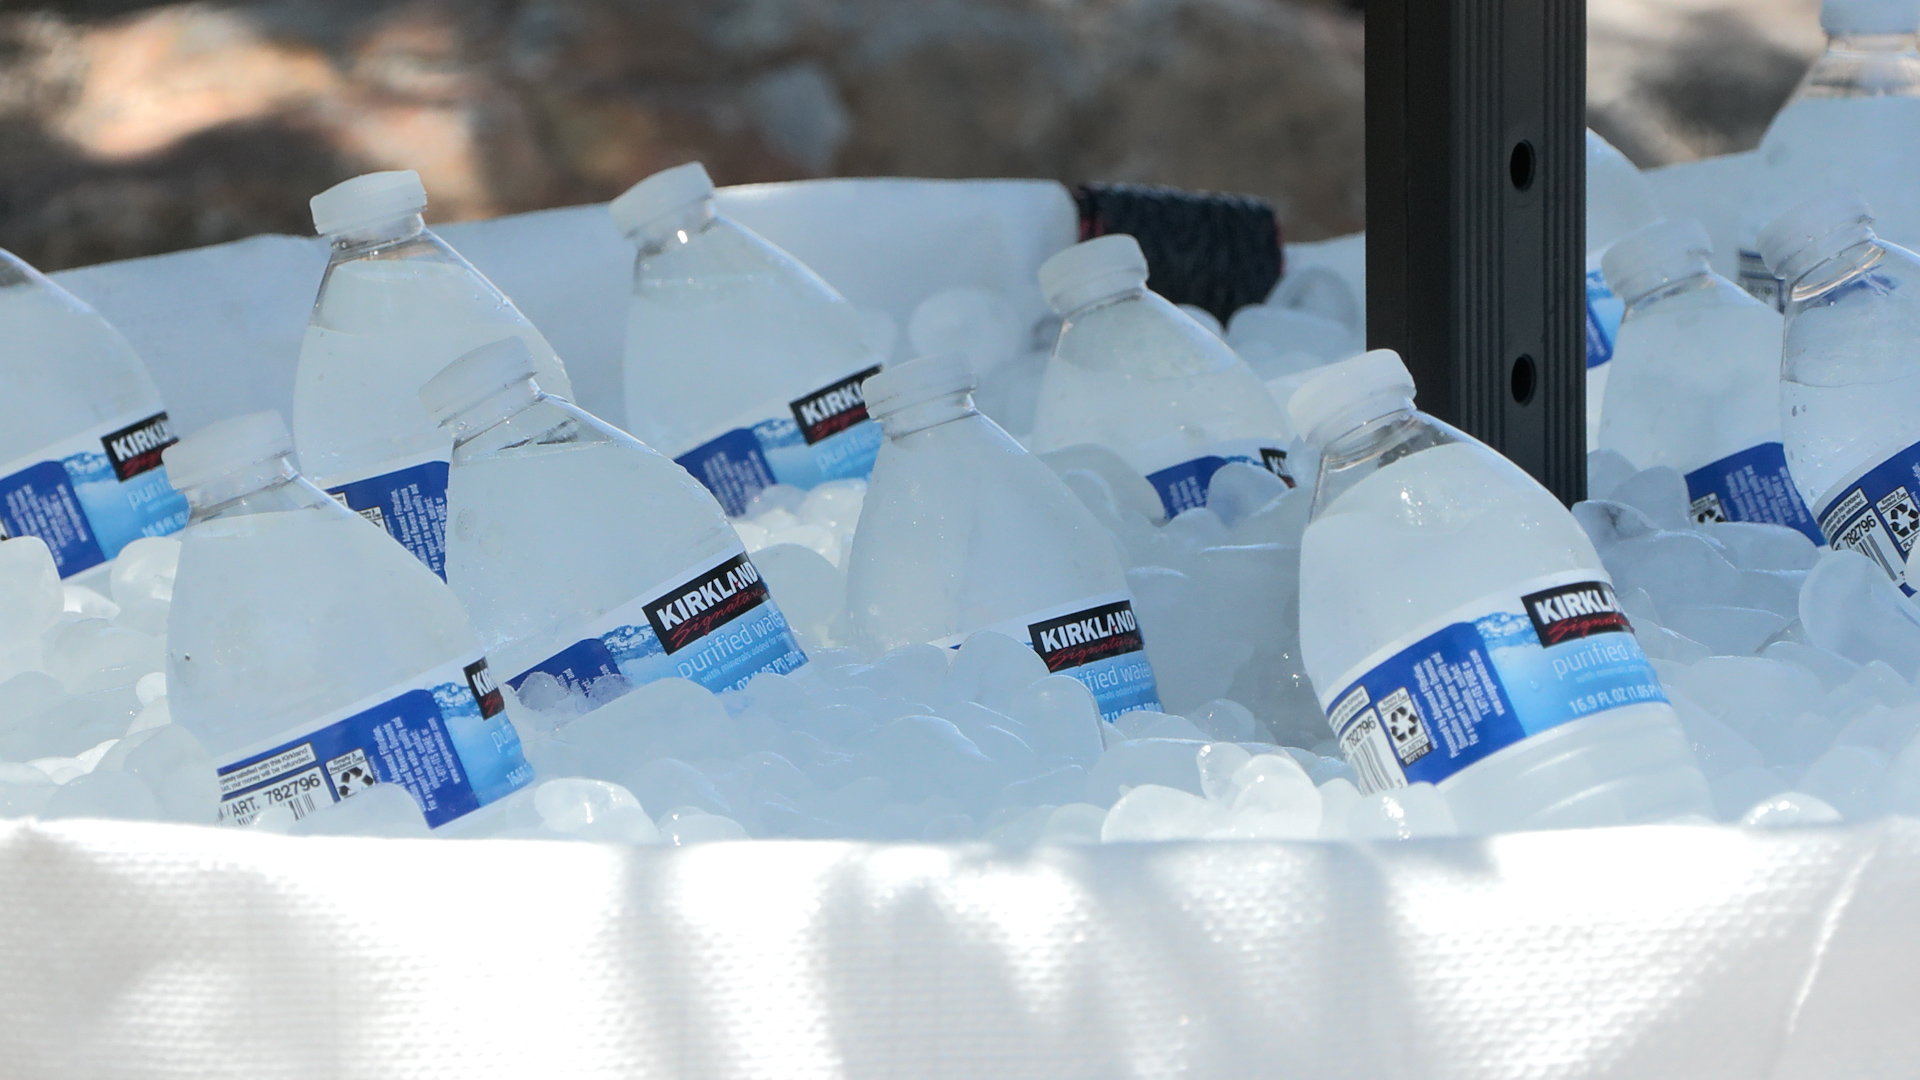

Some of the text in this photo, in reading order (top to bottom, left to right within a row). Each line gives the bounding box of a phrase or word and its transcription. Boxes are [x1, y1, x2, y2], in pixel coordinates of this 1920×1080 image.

[1842, 514, 1877, 550] 782796
[655, 561, 759, 632] KIRKLAND
[677, 610, 785, 680] purified wate
[1039, 609, 1137, 653] KIRKLAND
[720, 652, 751, 674] minerals
[1120, 661, 1150, 684] wate
[1552, 641, 1630, 681] purified
[1569, 695, 1598, 714] 16.9
[1597, 690, 1611, 706] FL
[1611, 686, 1626, 702] OZ
[281, 747, 308, 763] Kirkland
[1400, 735, 1428, 757] PLASTIC
[1404, 745, 1431, 765] BOTTLE
[281, 755, 312, 771] refunded.
[262, 774, 321, 805] 782796
